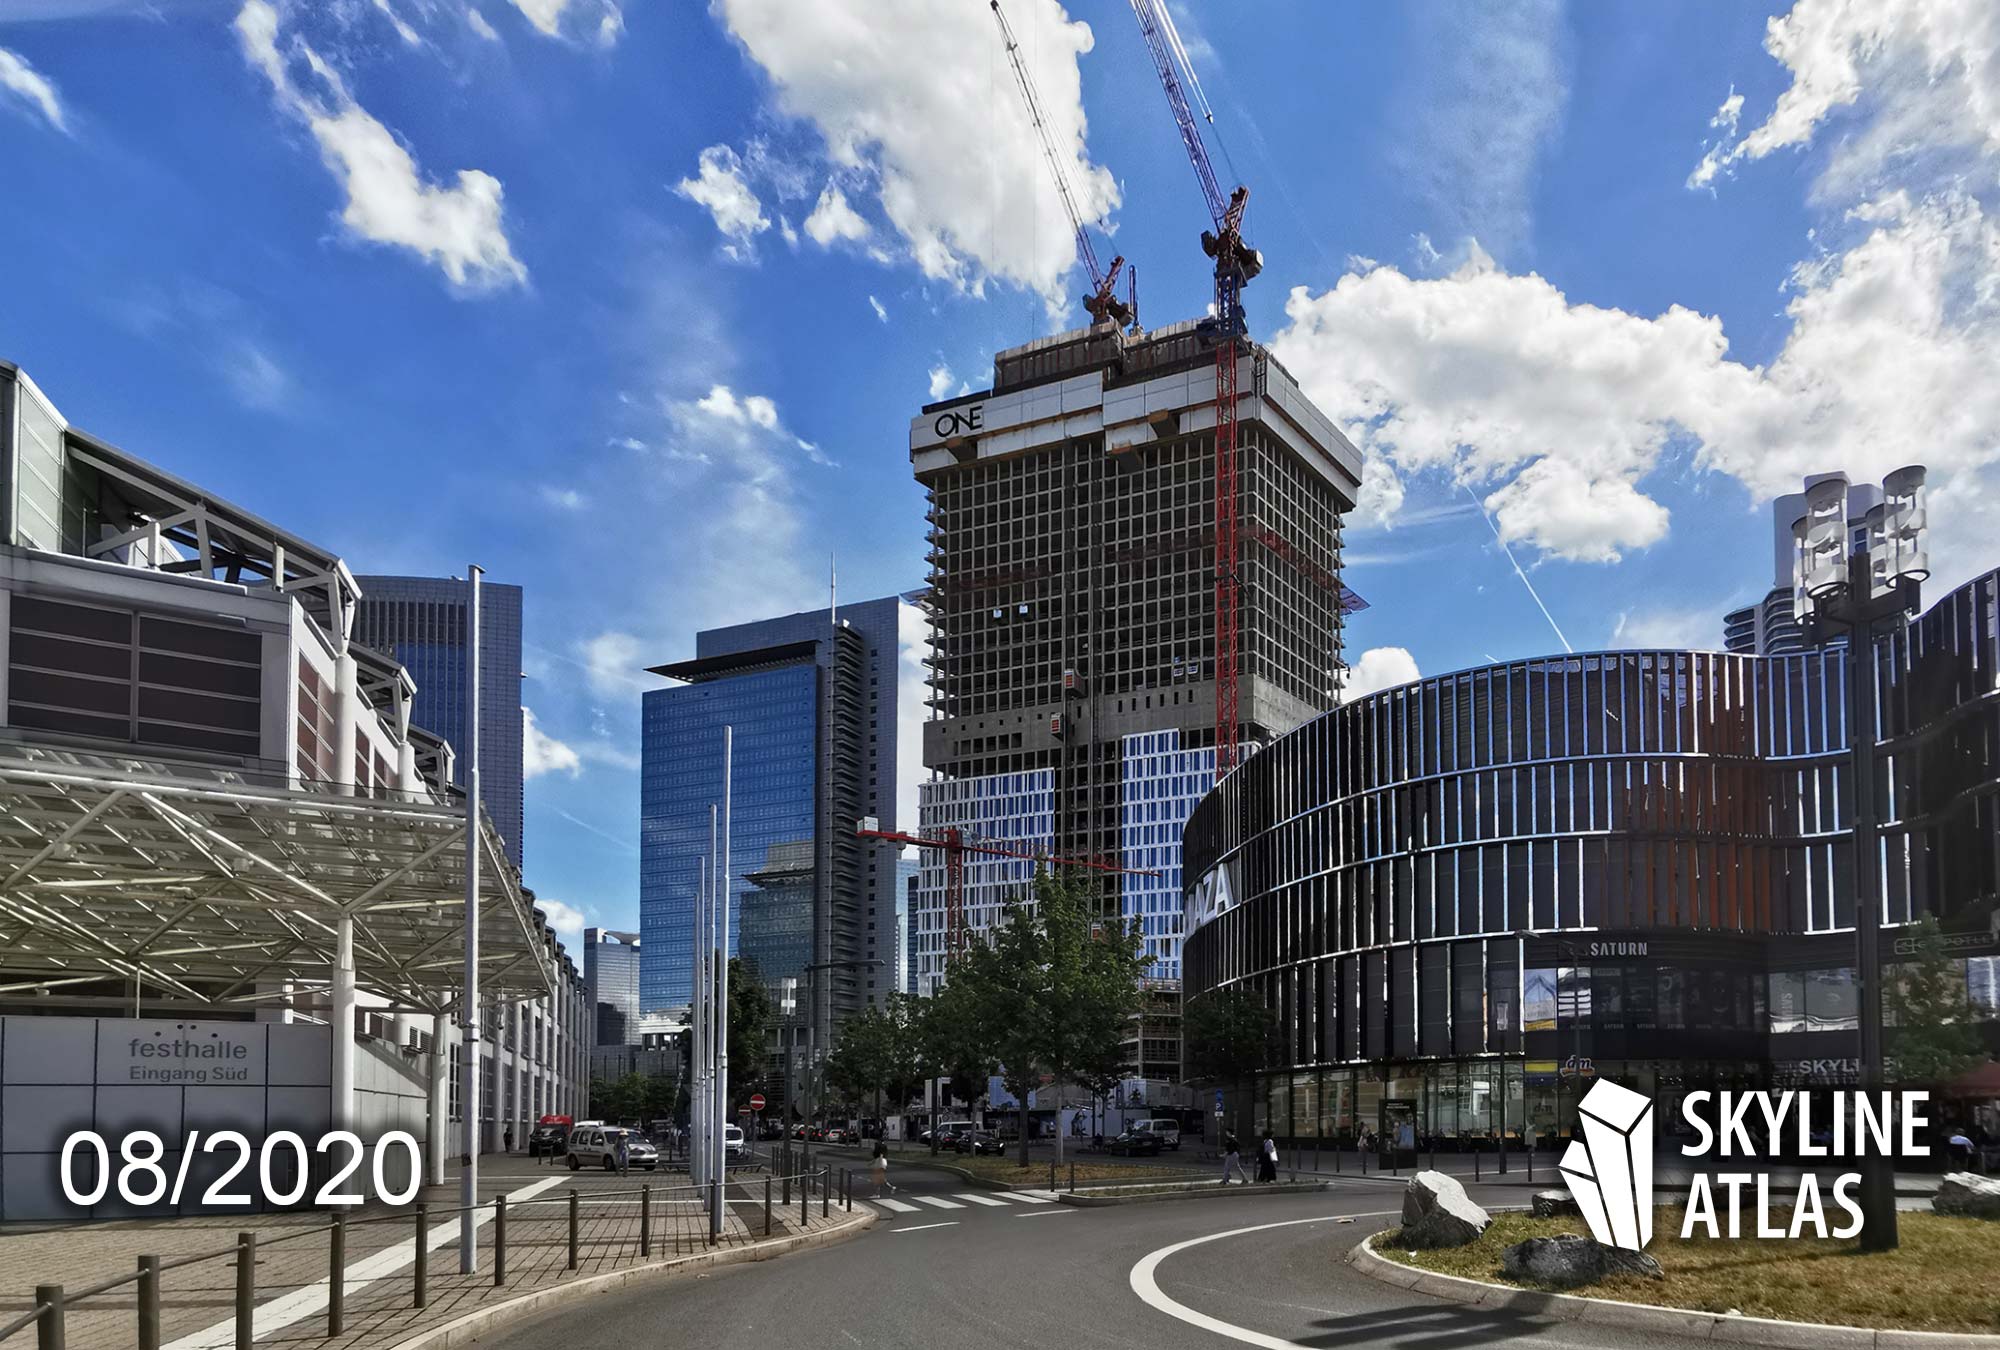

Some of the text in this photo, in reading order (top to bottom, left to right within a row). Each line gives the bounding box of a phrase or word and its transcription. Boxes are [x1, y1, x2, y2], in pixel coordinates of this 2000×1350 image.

[935, 405, 983, 437] ONE
[1590, 942, 1648, 956] SATURN
[128, 1038, 247, 1059] festhalle
[130, 1066, 248, 1083] Eingang Süd
